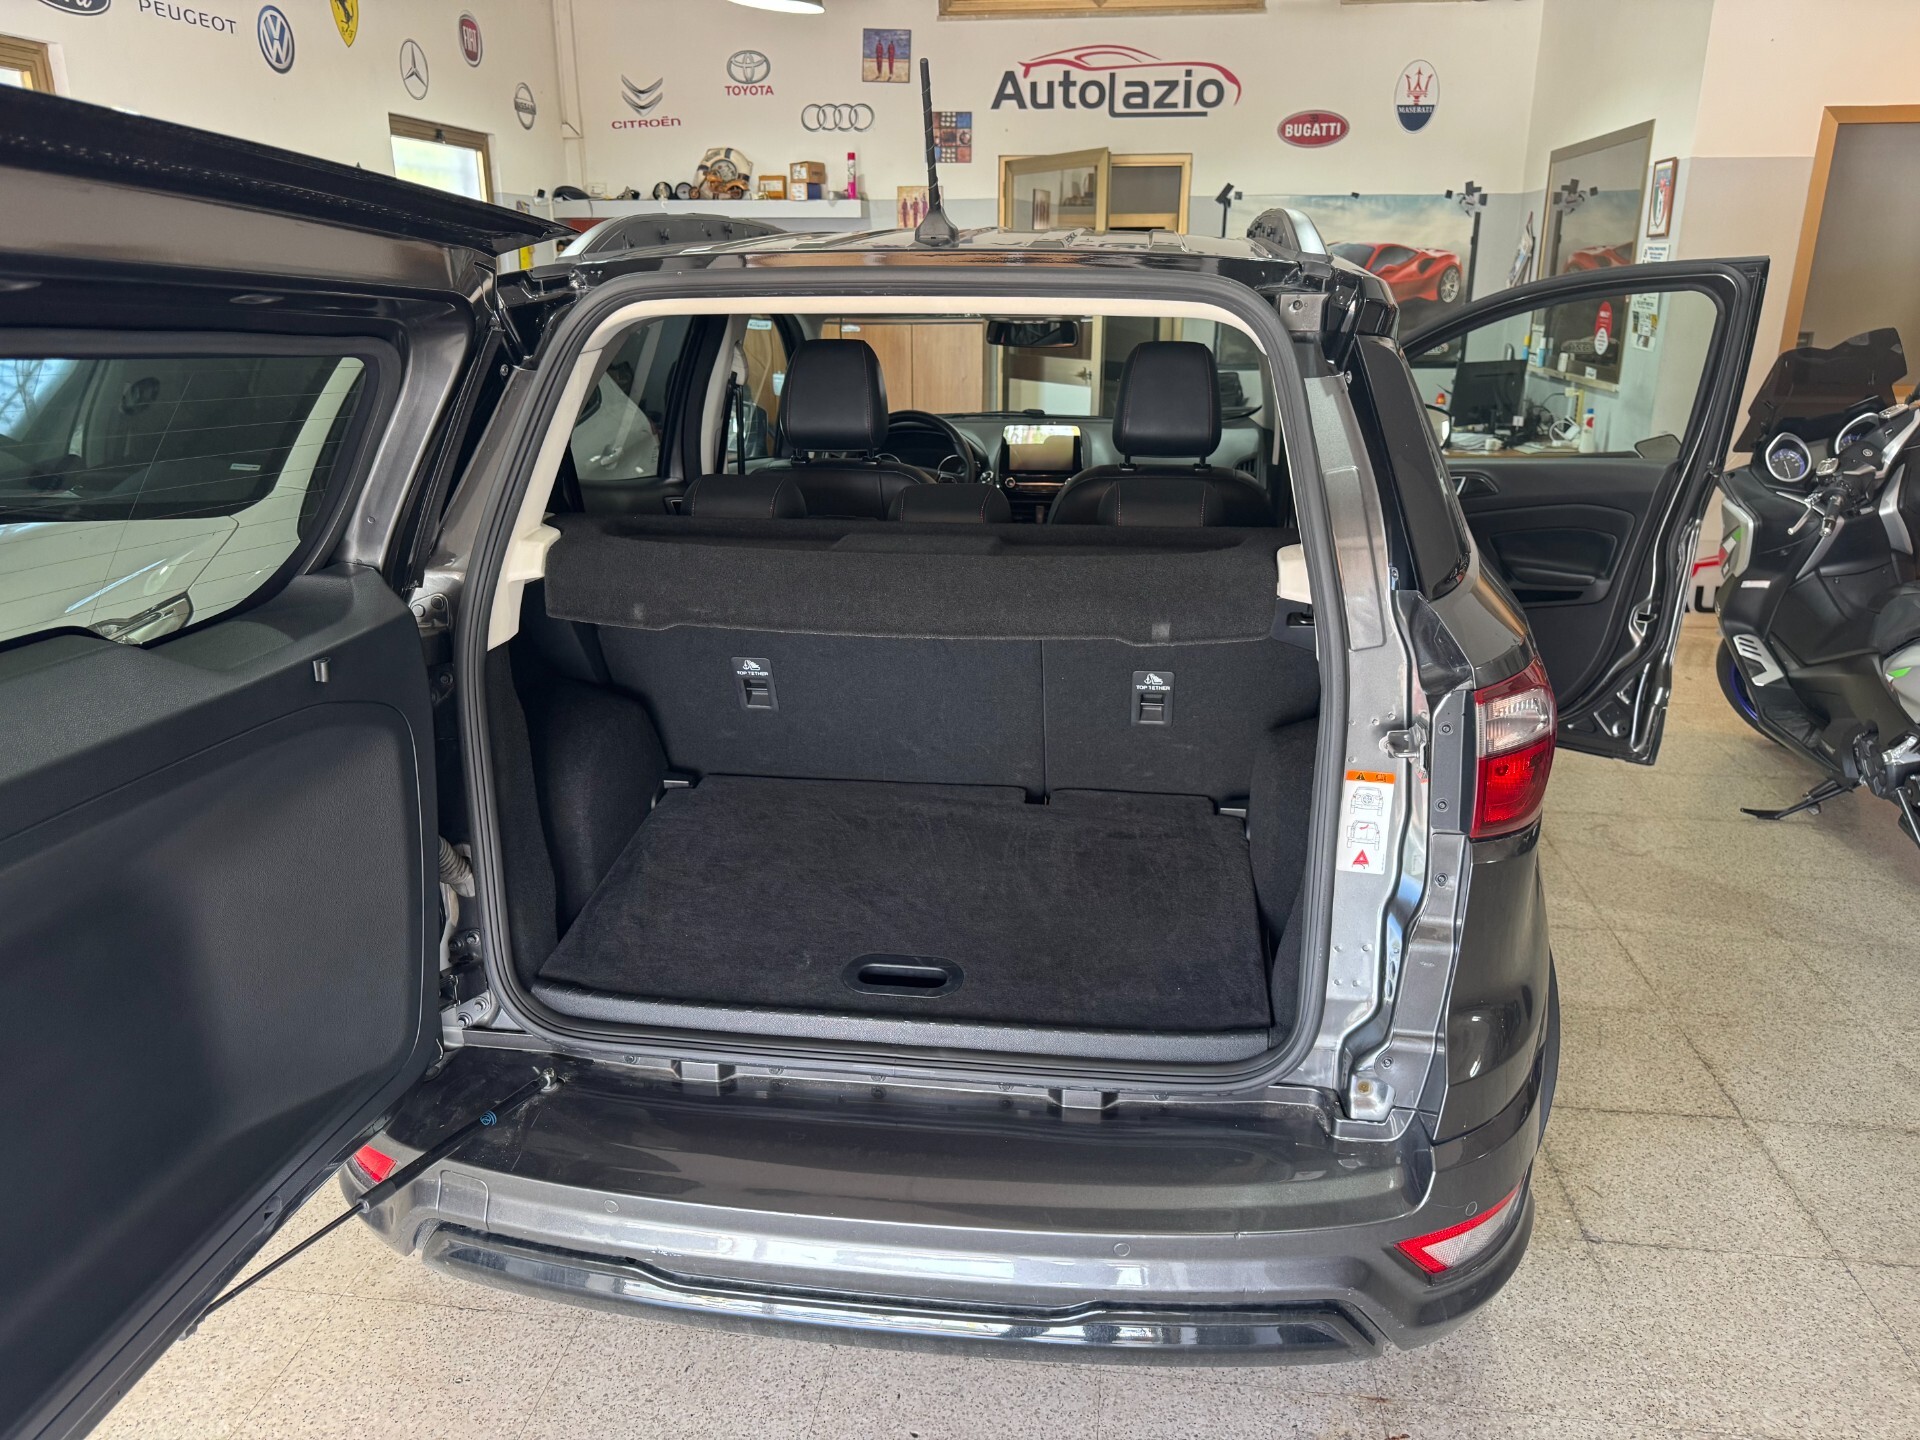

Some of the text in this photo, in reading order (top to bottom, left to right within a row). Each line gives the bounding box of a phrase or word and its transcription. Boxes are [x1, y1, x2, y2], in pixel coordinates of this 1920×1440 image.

[138, 0, 237, 34] PEUGEOT
[462, 25, 477, 53] FIAT
[724, 85, 775, 96] TOYOTA
[1284, 122, 1341, 137] BUGATTI
